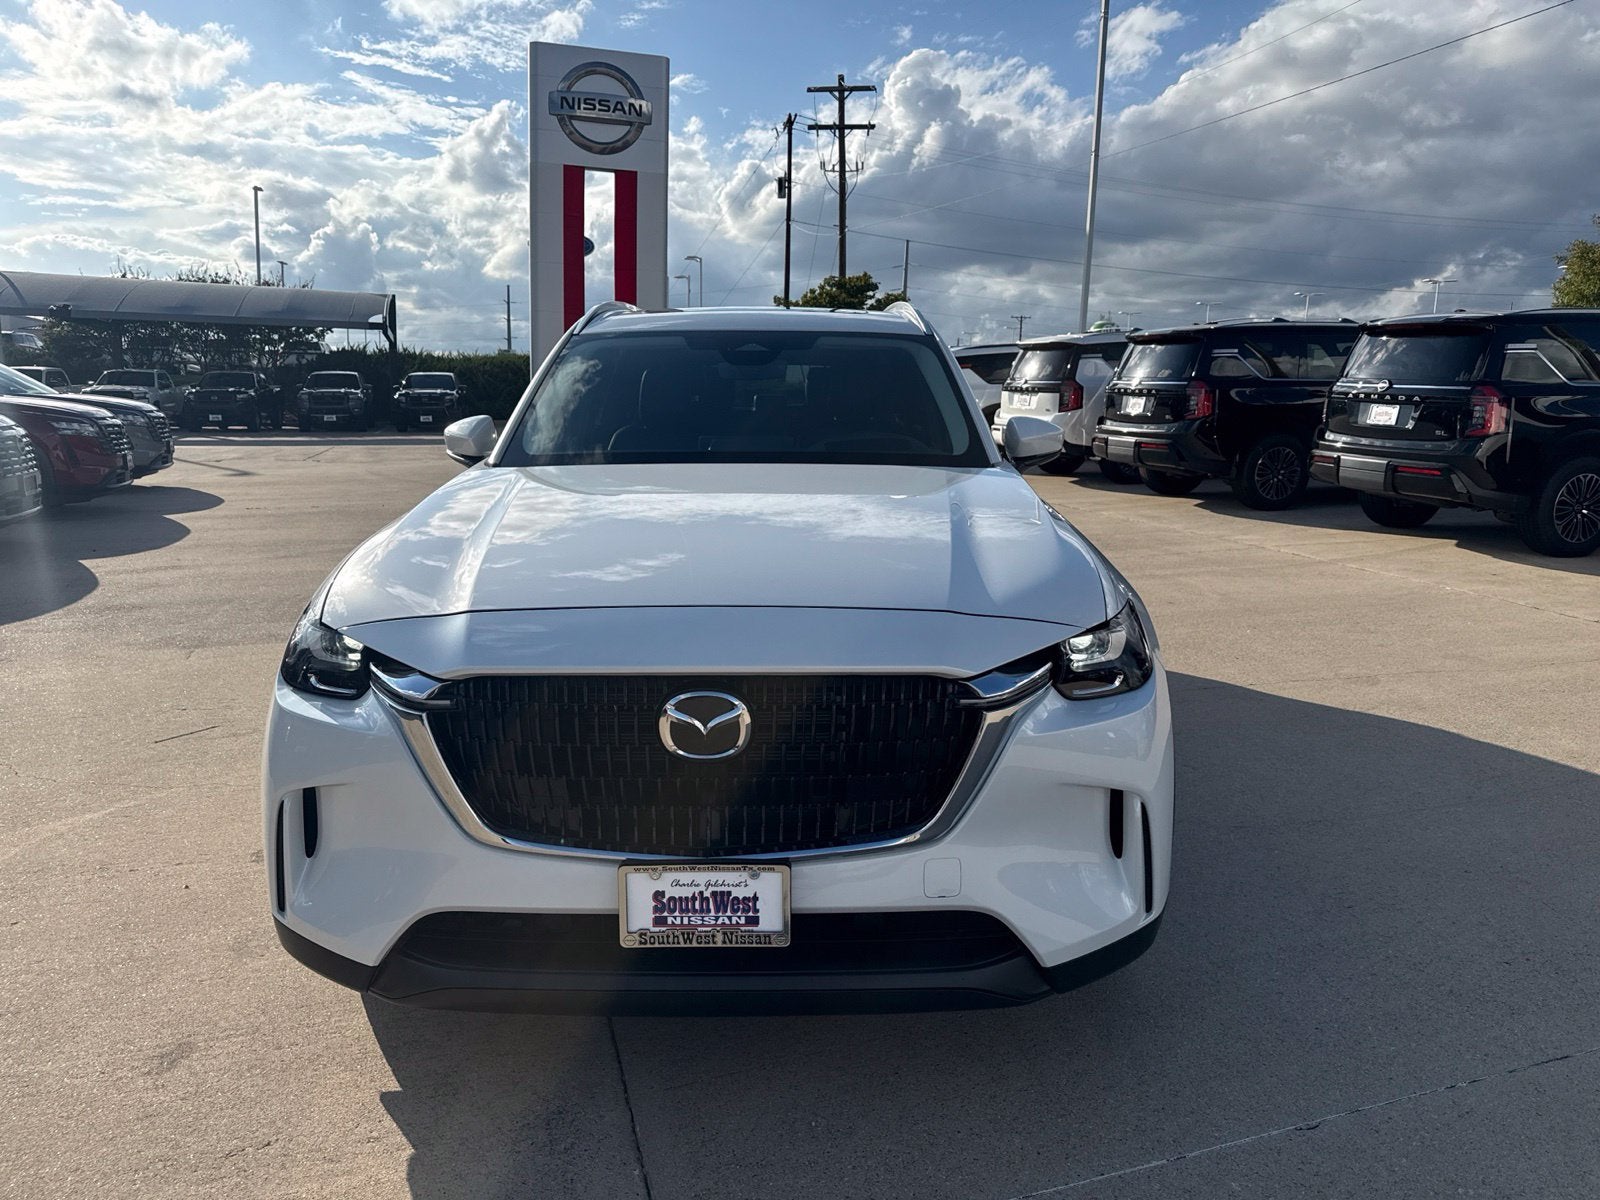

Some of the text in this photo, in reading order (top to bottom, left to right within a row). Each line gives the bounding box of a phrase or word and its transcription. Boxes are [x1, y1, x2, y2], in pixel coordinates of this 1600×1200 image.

[560, 96, 643, 117] NISSAN
[1347, 393, 1421, 401] ARMADA
[633, 865, 776, 873] www.SouthWestNissanTx.com
[670, 879, 750, 891] Charlie Gilchrist's
[652, 890, 760, 915] SouthWest
[667, 916, 746, 925] NISSAN
[638, 931, 716, 946] SouthWest
[722, 931, 772, 946] Nissan
